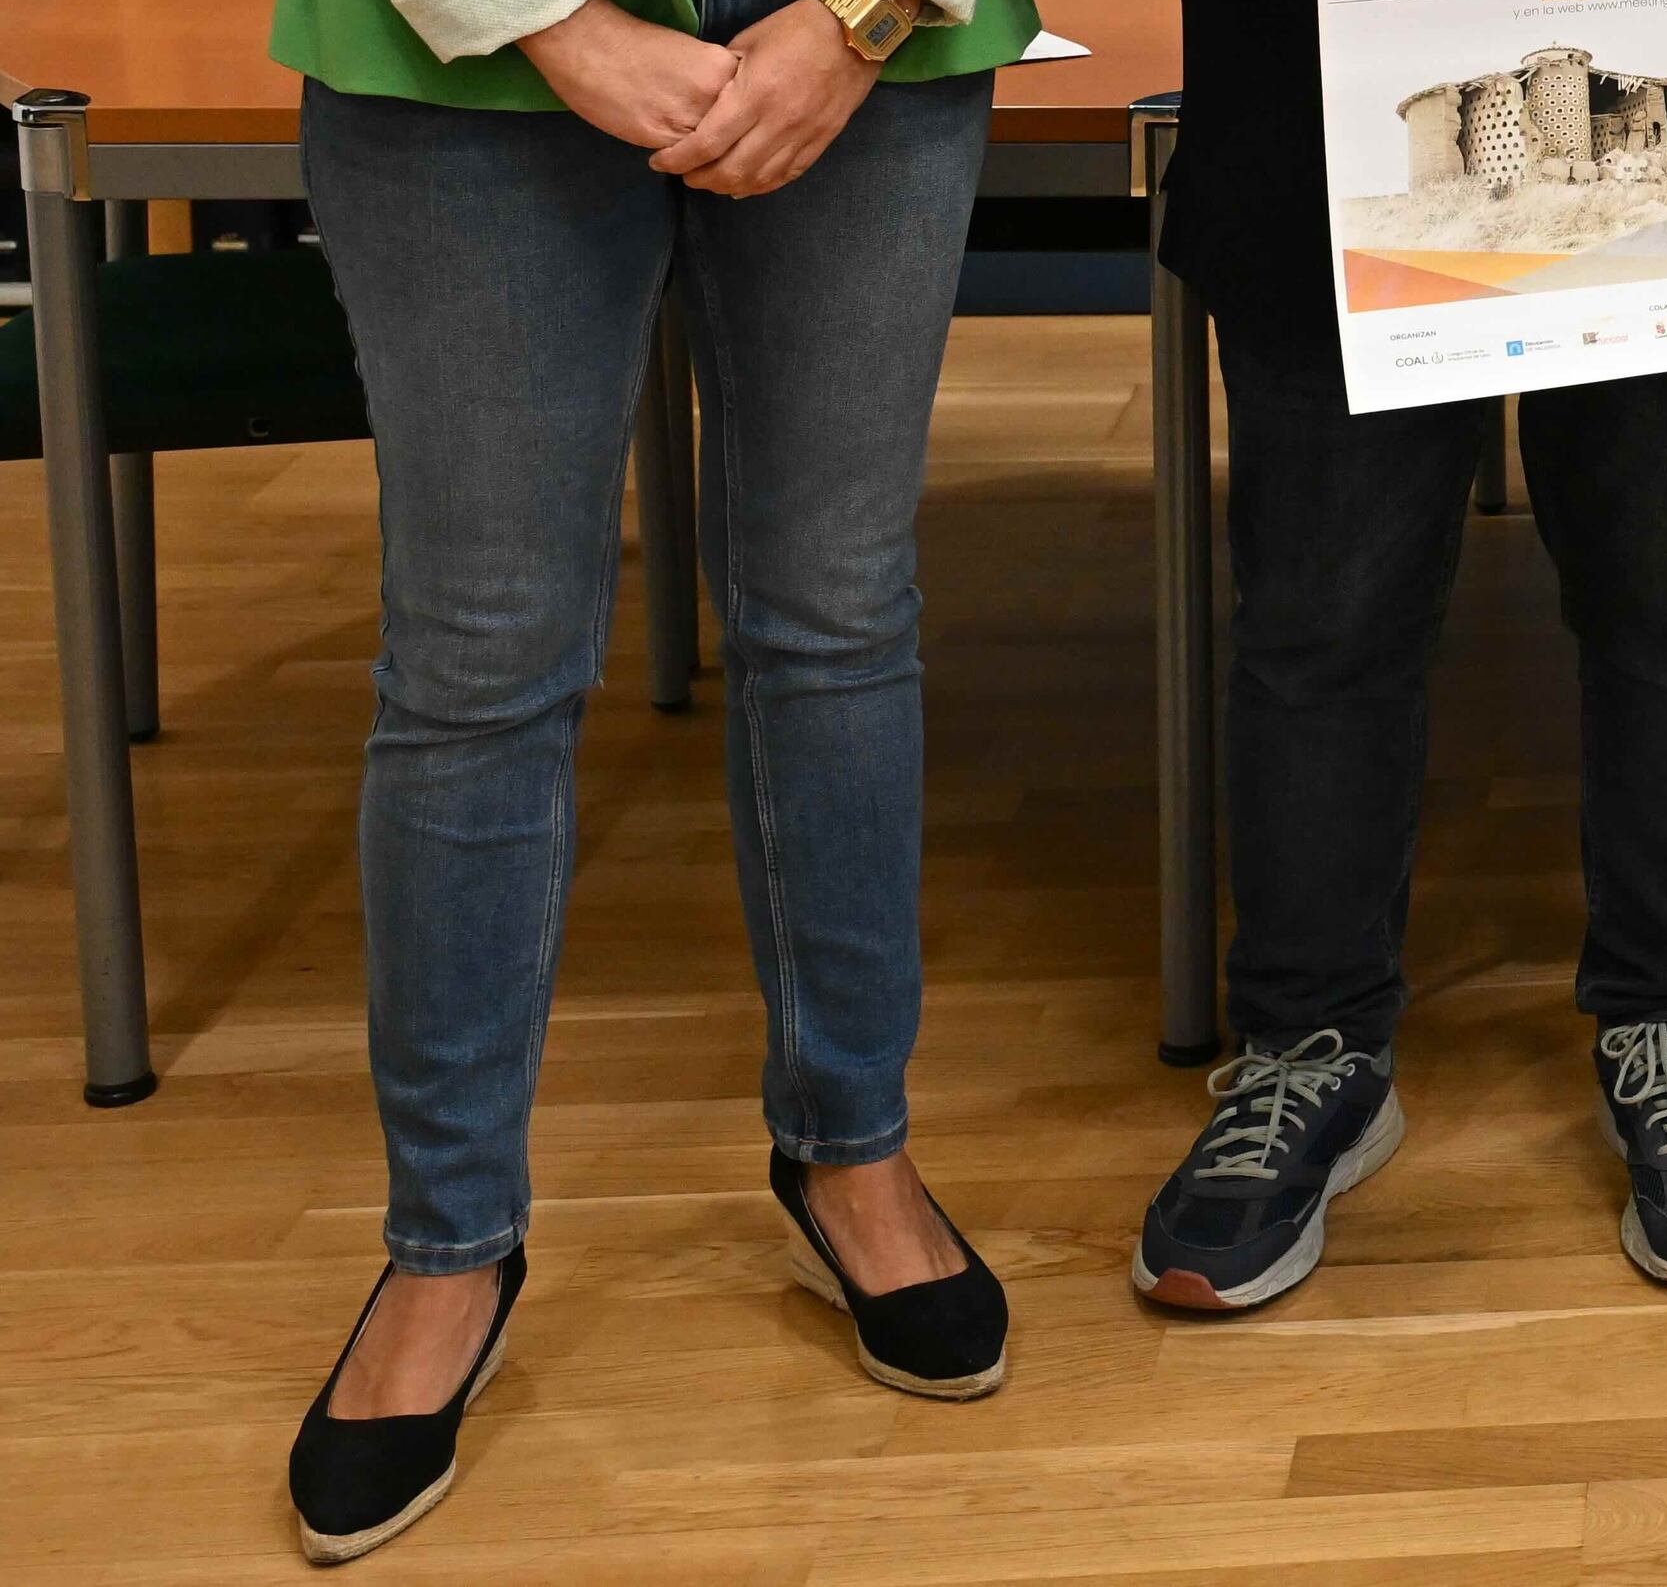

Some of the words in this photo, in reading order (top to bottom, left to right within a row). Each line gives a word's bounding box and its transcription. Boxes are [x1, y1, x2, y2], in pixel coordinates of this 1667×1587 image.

[1513, 10, 1520, 20] y
[1524, 8, 1540, 17] en
[1543, 6, 1554, 15] la
[1558, 3, 1584, 14] web
[1396, 356, 1428, 367] COAL
